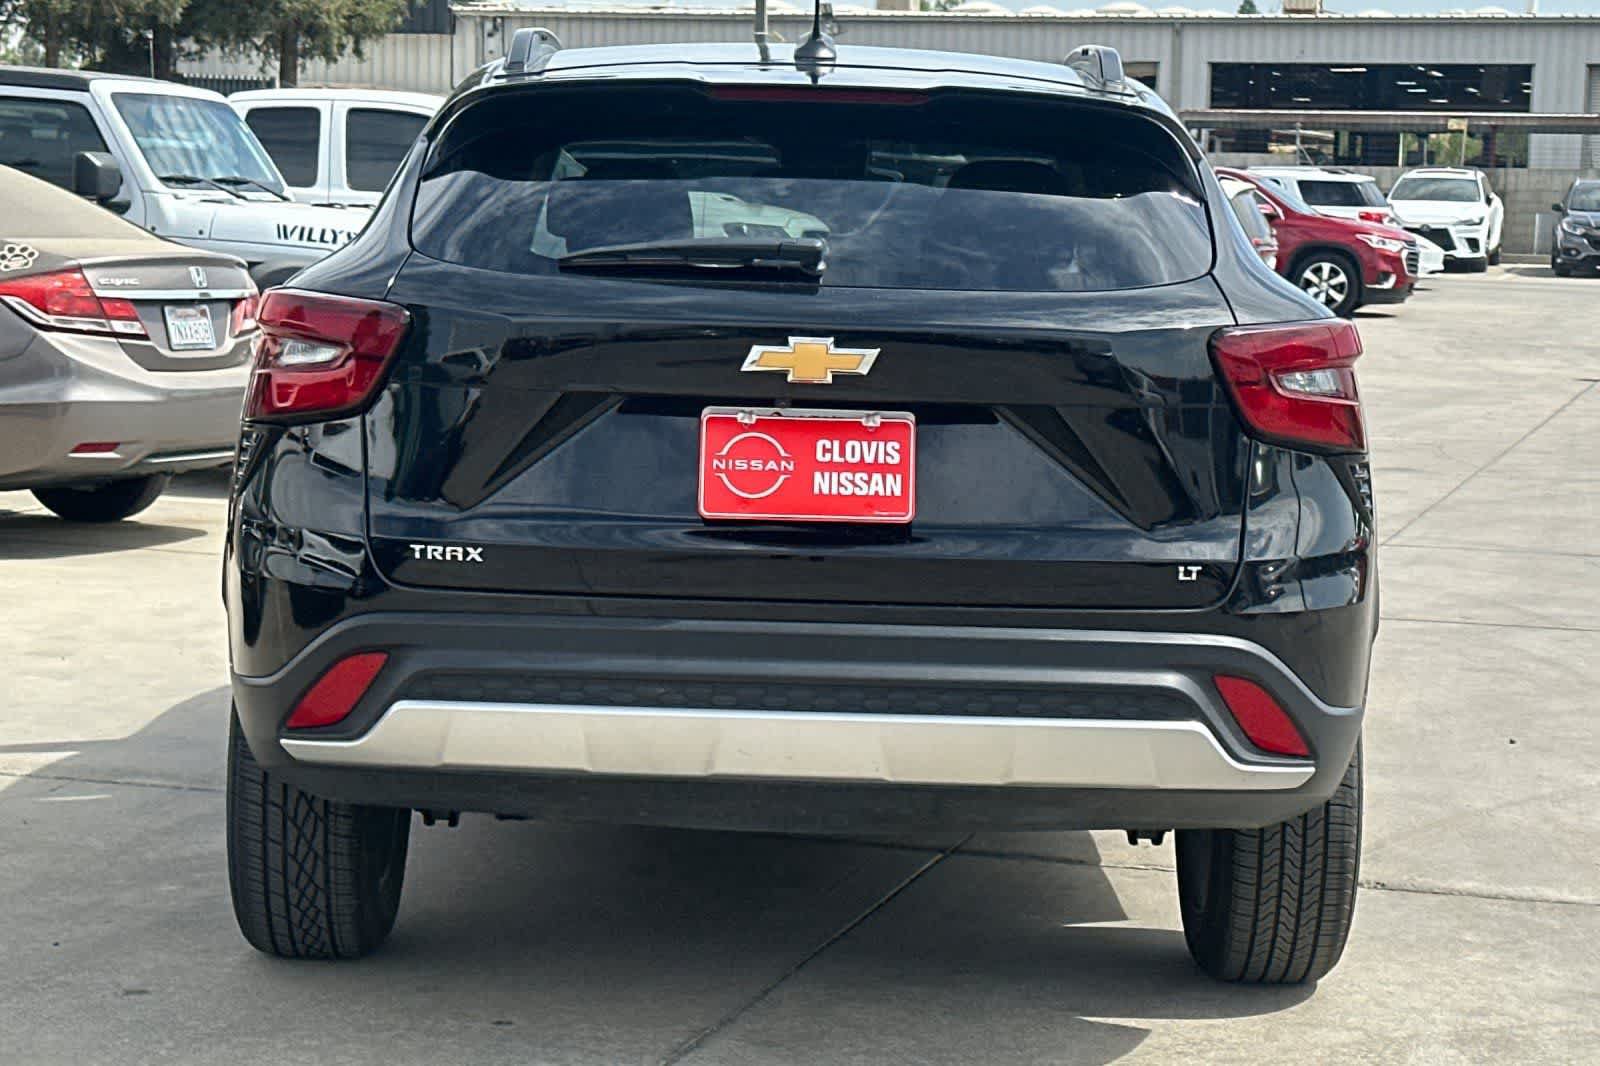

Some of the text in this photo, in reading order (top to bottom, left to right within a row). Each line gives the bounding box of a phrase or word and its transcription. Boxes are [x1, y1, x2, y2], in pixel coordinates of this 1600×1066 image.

[815, 439, 900, 464] CLOVIS
[712, 458, 794, 471] NISSAN
[813, 471, 902, 497] NISSAN
[409, 544, 484, 562] TRAX
[1178, 566, 1202, 581] LT
